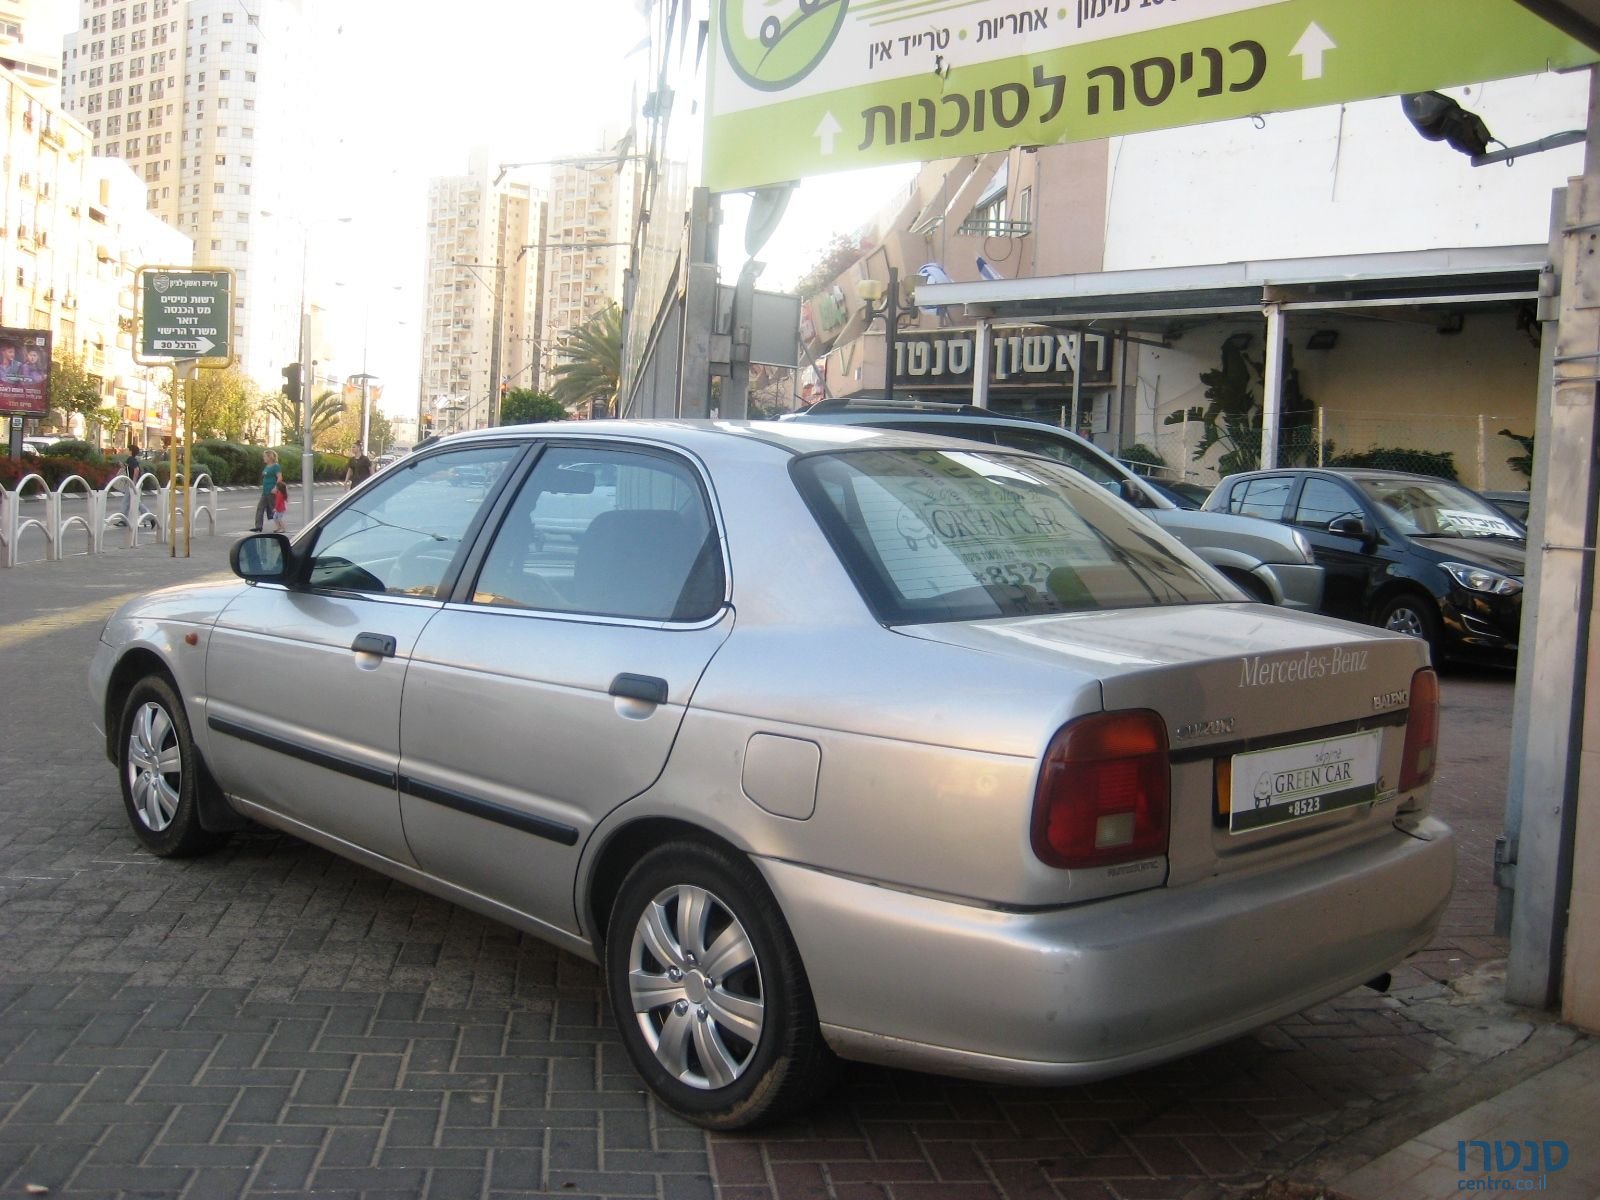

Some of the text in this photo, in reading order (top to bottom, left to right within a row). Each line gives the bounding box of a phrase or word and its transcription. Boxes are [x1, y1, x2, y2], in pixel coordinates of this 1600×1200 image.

[976, 7, 1048, 43] אחריות
[869, 40, 893, 69] אין
[898, 28, 950, 56] טרייד
[858, 40, 1267, 151] כניסה לסוכנות
[164, 306, 211, 314] מס הכנסה
[176, 316, 198, 324] דואר
[157, 327, 217, 335] משרד הרישוי
[161, 341, 197, 349] הרצל 30
[994, 333, 1105, 380] ראשון
[931, 508, 1016, 538] GREEN
[1239, 647, 1368, 688] Mercedes-Benz
[1275, 762, 1351, 794] GREEN CAR
